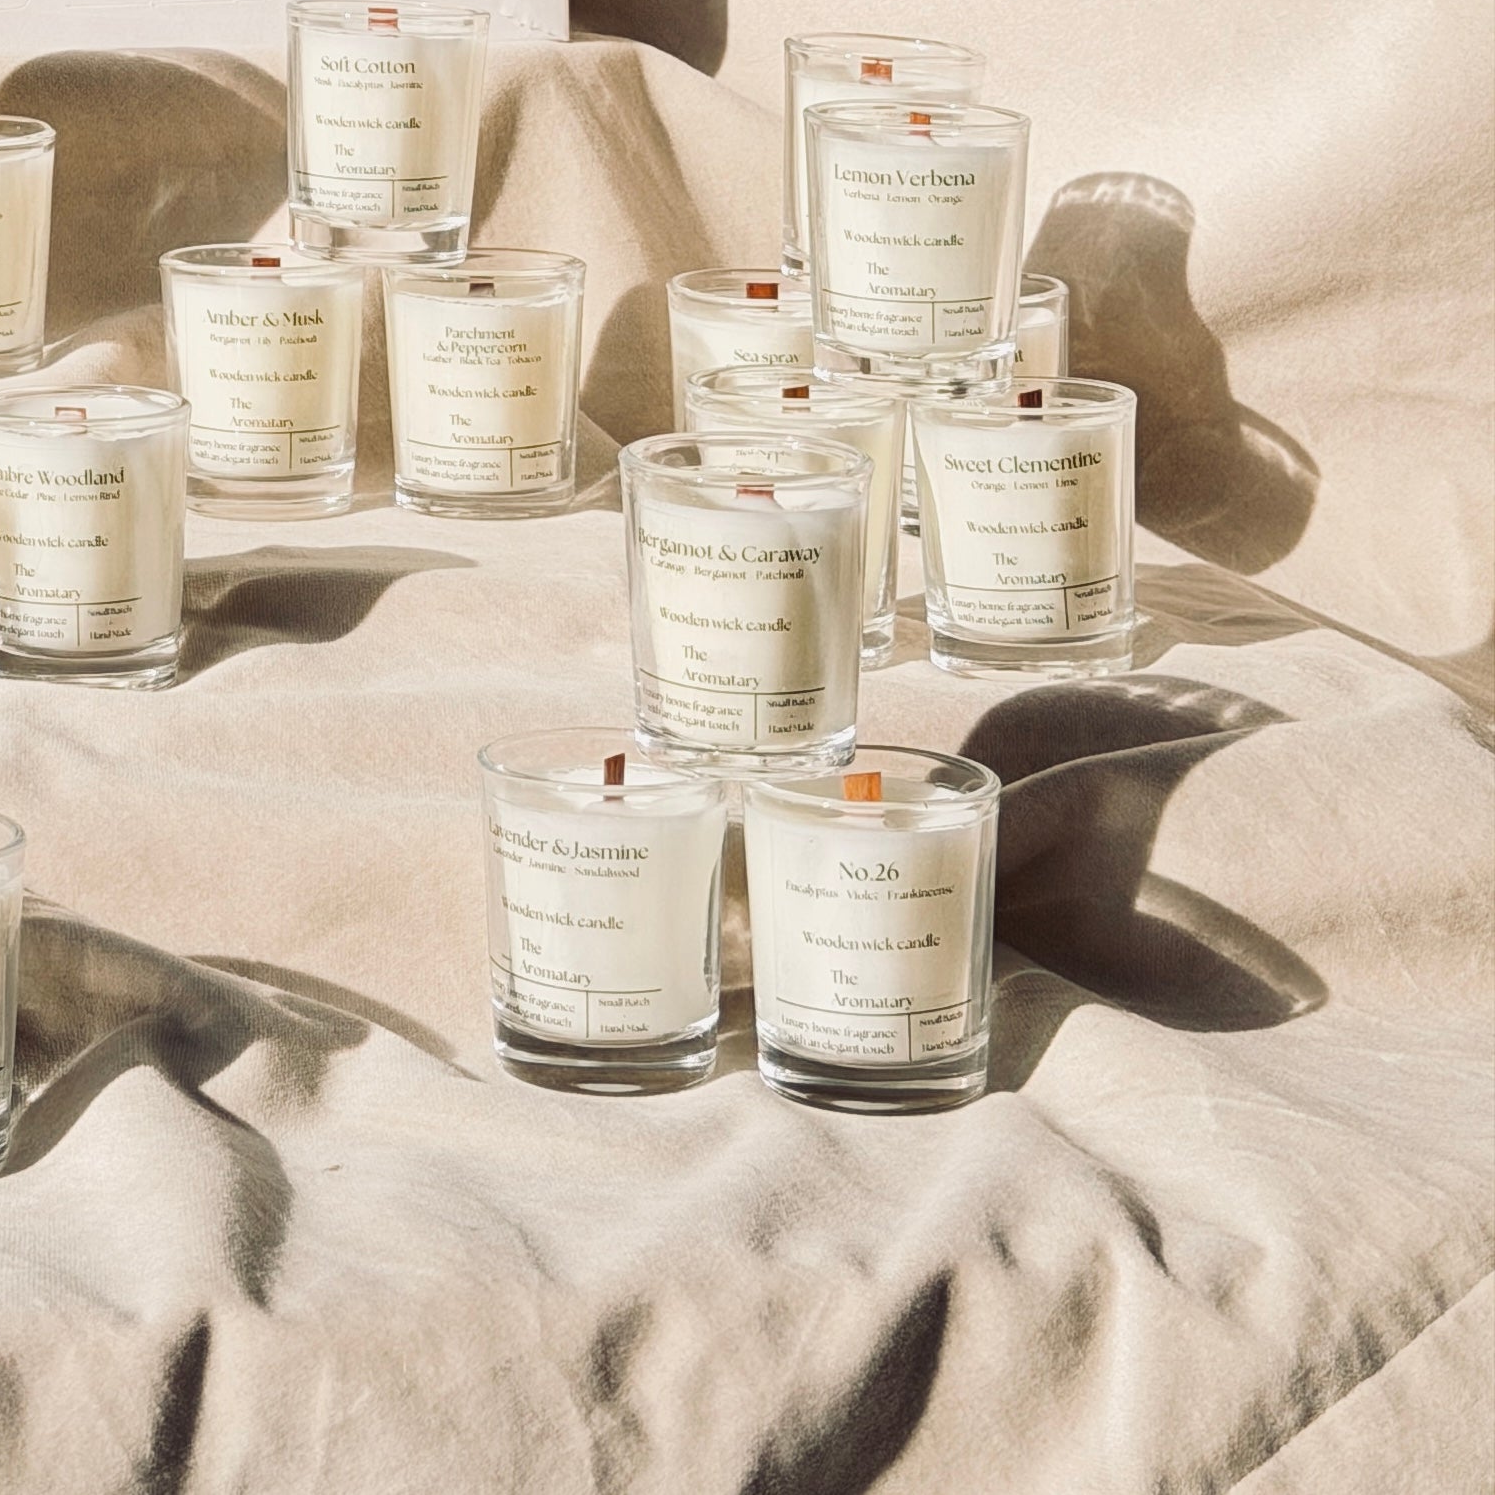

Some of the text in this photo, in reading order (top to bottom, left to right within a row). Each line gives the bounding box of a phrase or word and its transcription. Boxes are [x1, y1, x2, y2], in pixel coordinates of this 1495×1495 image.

[321, 55, 416, 74] Soft Cotton
[834, 163, 975, 187] Lemon Verbena
[866, 262, 890, 276] The
[203, 308, 324, 327] Amber & Musk
[445, 326, 515, 340] Parchment
[451, 342, 527, 356] Peppercorn
[944, 450, 1102, 474] Sweet Clementine
[37, 466, 125, 486] Woodland
[638, 526, 824, 564] Bergamot & Caraway
[488, 815, 649, 861] Lavender & Jasmine
[840, 861, 899, 882] No.26
[802, 930, 859, 951] Wooden
[830, 969, 858, 986] The
